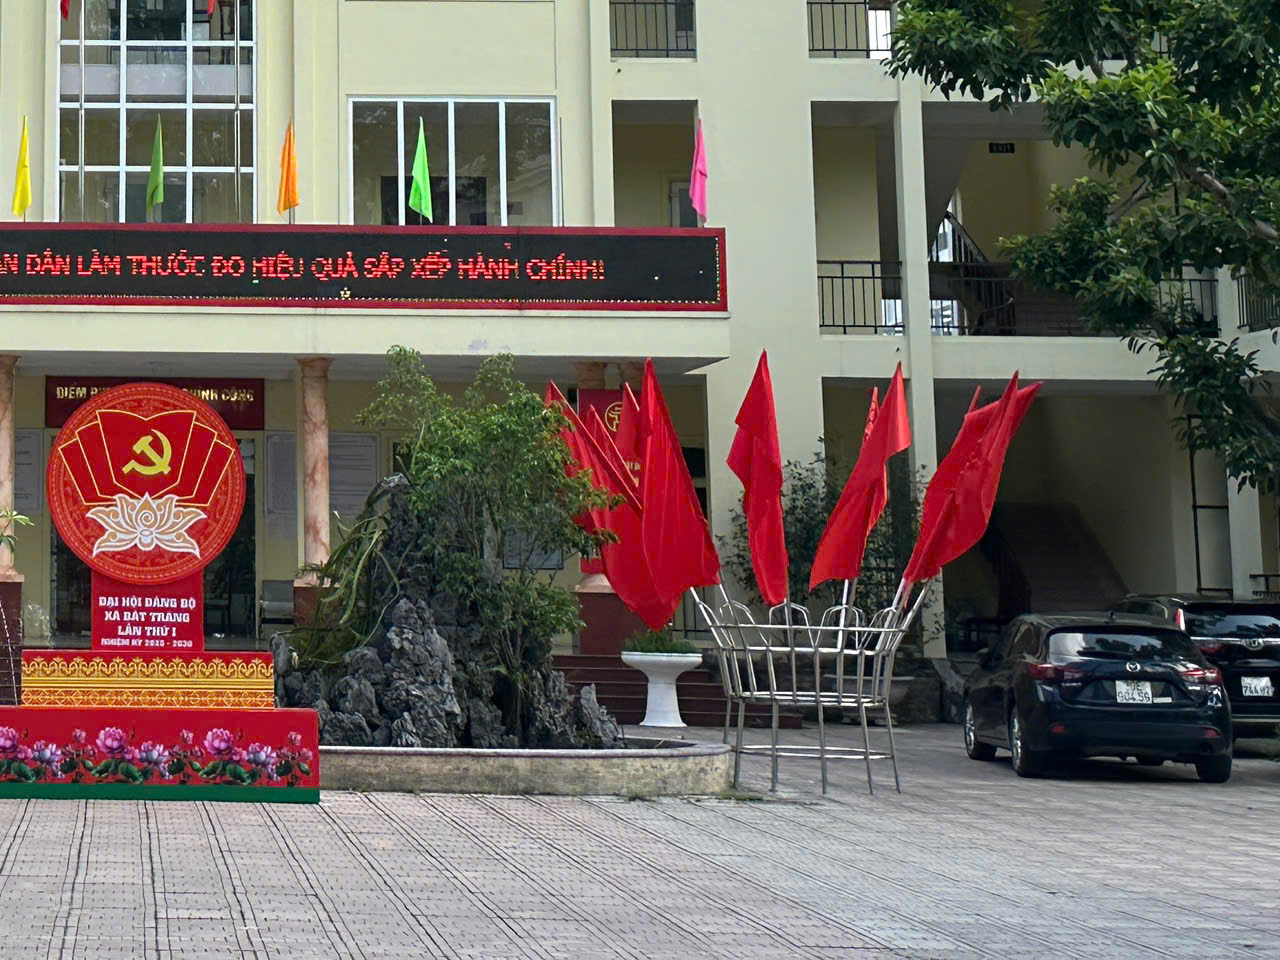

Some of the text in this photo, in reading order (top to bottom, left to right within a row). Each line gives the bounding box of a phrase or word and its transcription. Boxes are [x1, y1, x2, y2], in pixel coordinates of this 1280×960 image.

[26, 248, 71, 275] DÂN
[77, 249, 121, 276] LÀM
[211, 255, 245, 278] ĐO
[310, 251, 359, 281] QUẢ
[458, 252, 519, 279] HÀNH
[99, 596, 119, 608] ĐẠI
[121, 595, 142, 608] HỘI
[180, 597, 196, 610] BỘ
